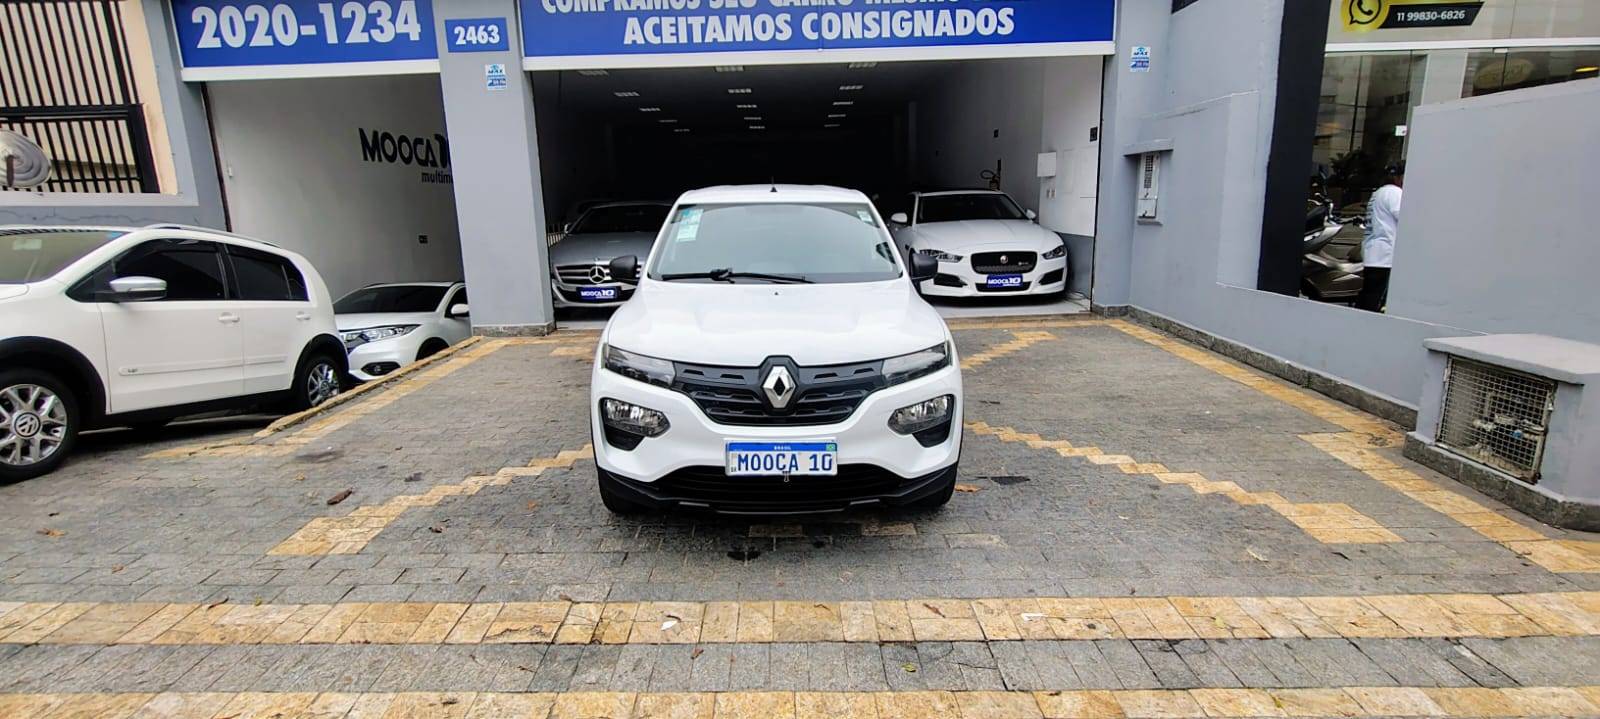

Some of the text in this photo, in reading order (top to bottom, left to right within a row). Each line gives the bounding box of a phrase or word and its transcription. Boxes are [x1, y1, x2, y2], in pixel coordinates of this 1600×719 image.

[192, 0, 421, 48] 2020-1234
[1397, 10, 1466, 22] 11 99830-6826
[454, 24, 500, 45] 2463
[624, 7, 1015, 45] ACEITAMOS CONSIGNADOS
[421, 170, 454, 184] multim
[738, 453, 832, 471] MOOCA 10
